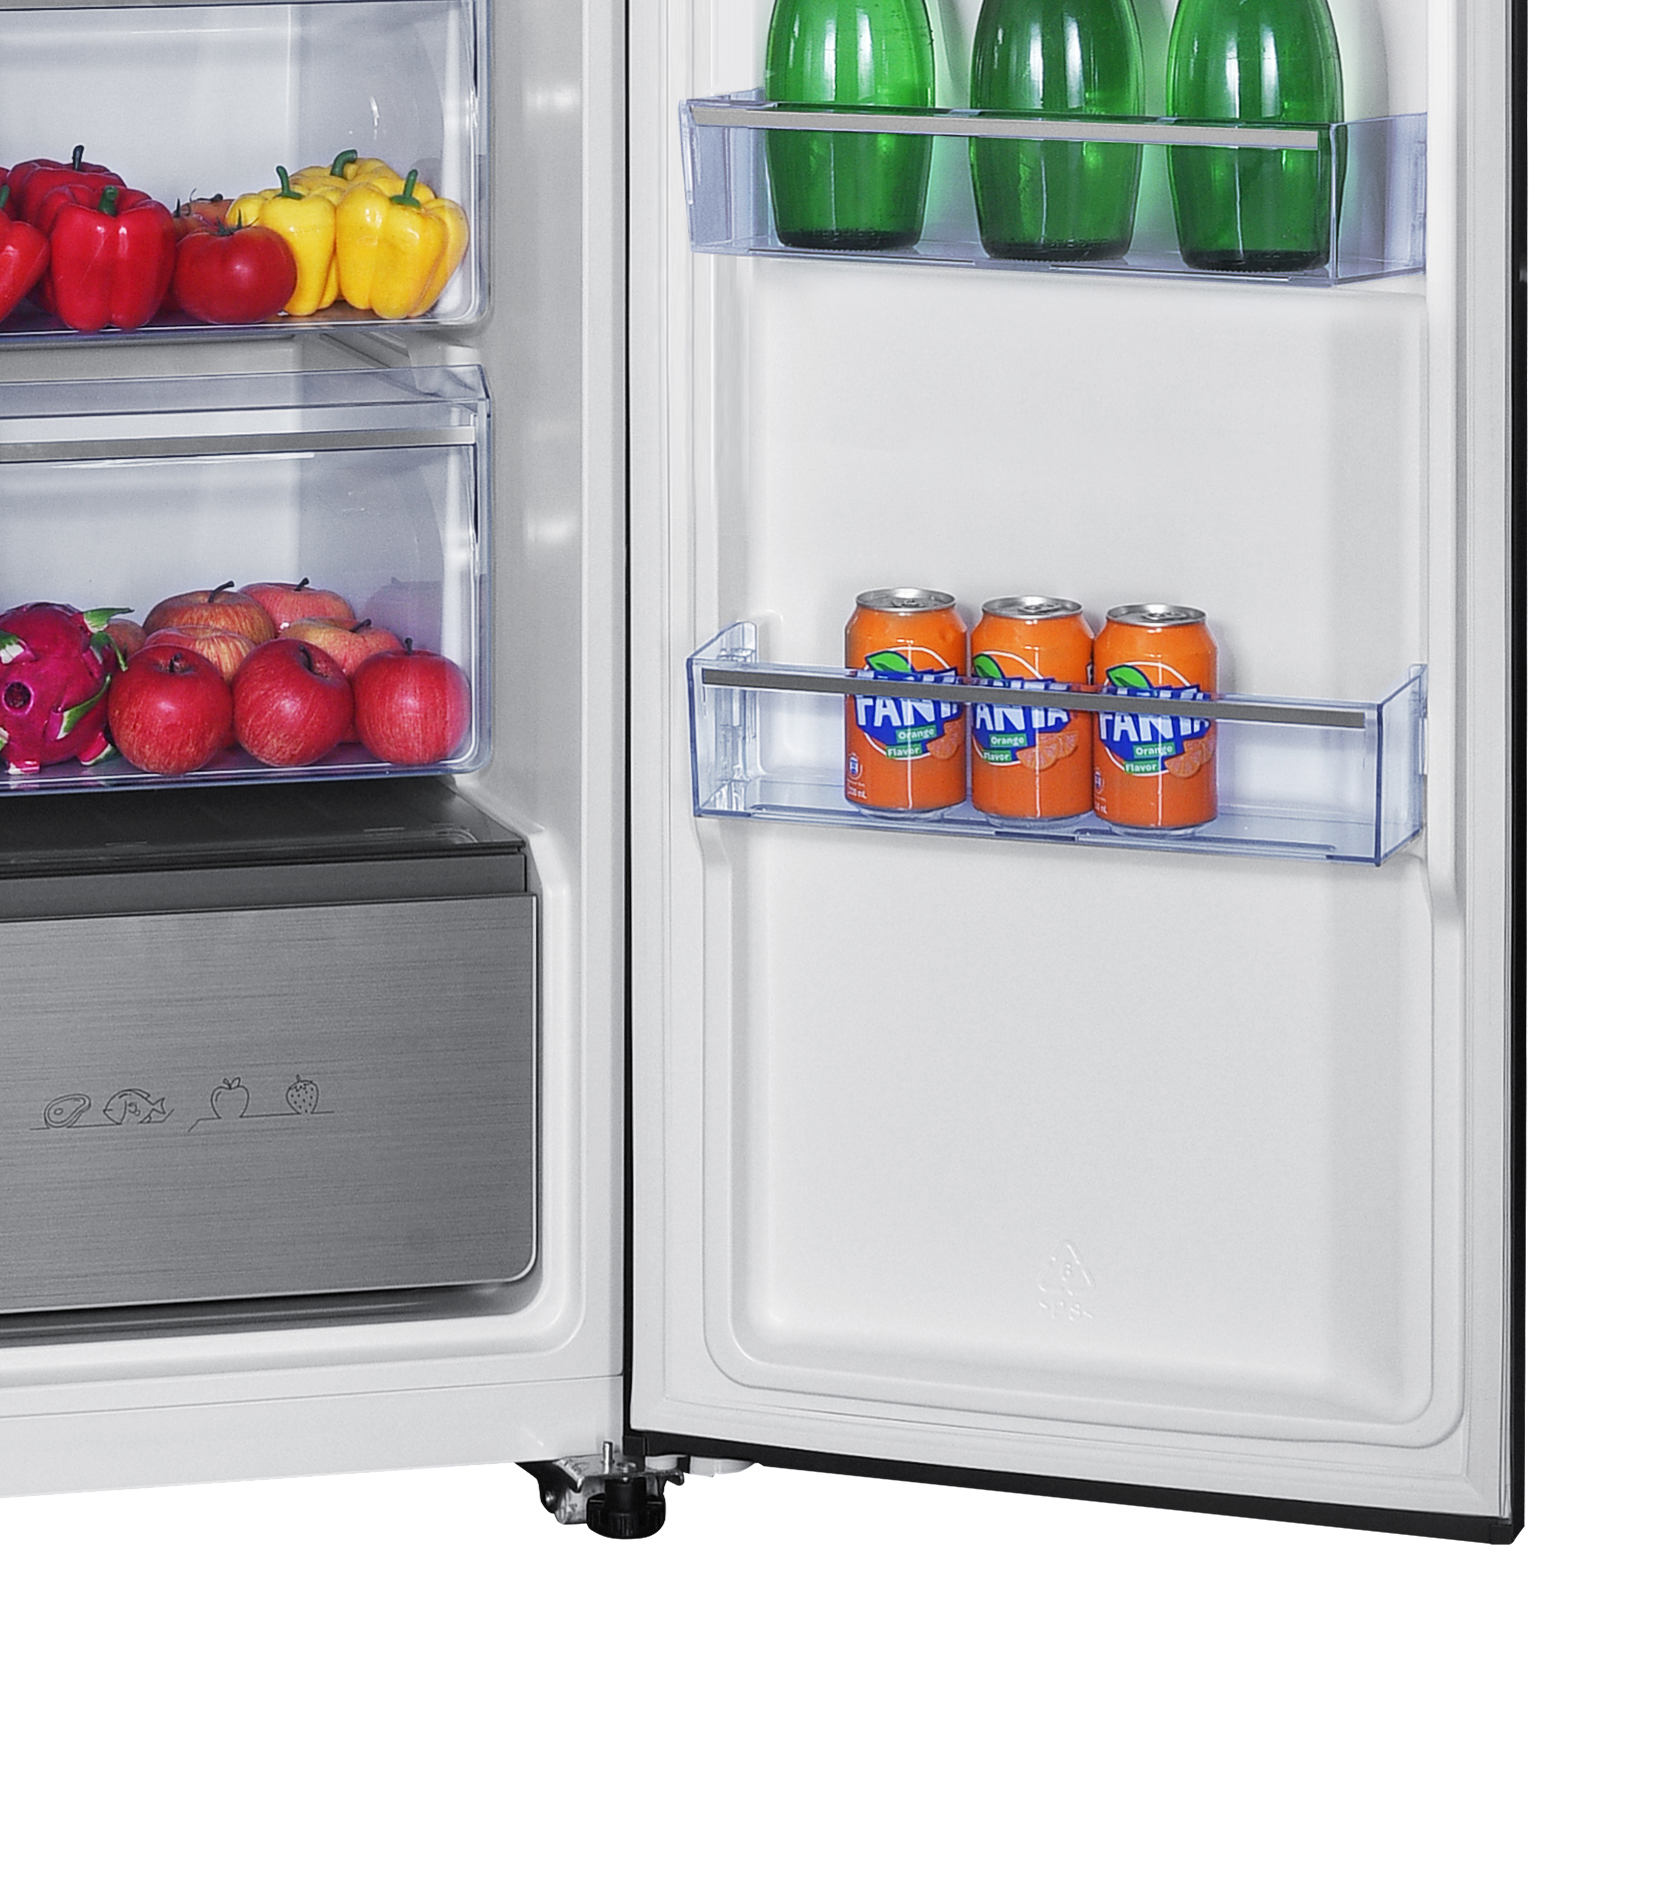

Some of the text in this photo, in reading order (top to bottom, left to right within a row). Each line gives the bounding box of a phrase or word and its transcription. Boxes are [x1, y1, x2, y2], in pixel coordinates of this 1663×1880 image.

[976, 702, 1069, 732] ANTA
[897, 726, 936, 740] Orange
[990, 735, 1025, 748] Orange
[887, 746, 921, 758] Flavor
[1135, 745, 1173, 757] Orange
[1125, 762, 1158, 773] Flavor
